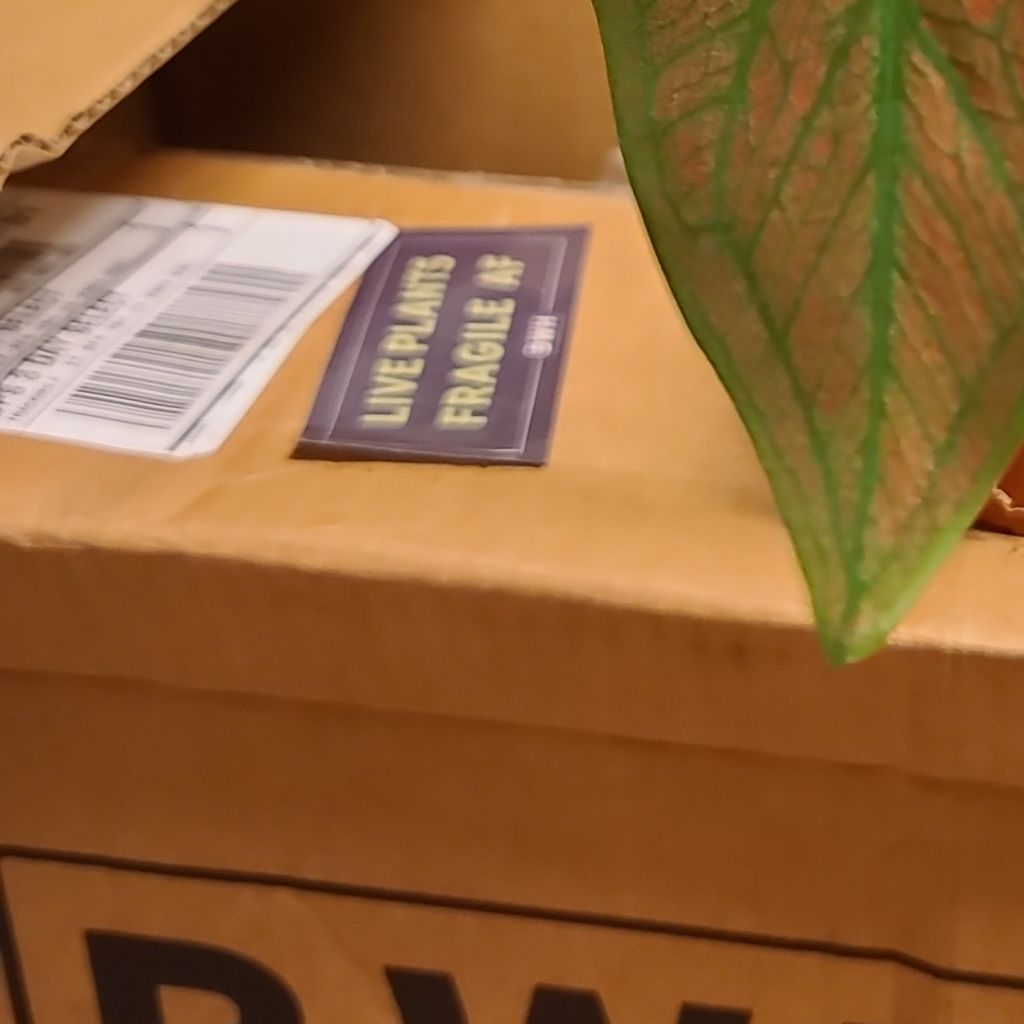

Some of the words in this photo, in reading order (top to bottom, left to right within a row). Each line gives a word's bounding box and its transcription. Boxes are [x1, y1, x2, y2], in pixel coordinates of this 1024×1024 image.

[378, 254, 456, 355] PLANTS
[474, 254, 525, 292] AF
[359, 358, 425, 428] LIVE
[434, 297, 516, 429] FRAGILE
